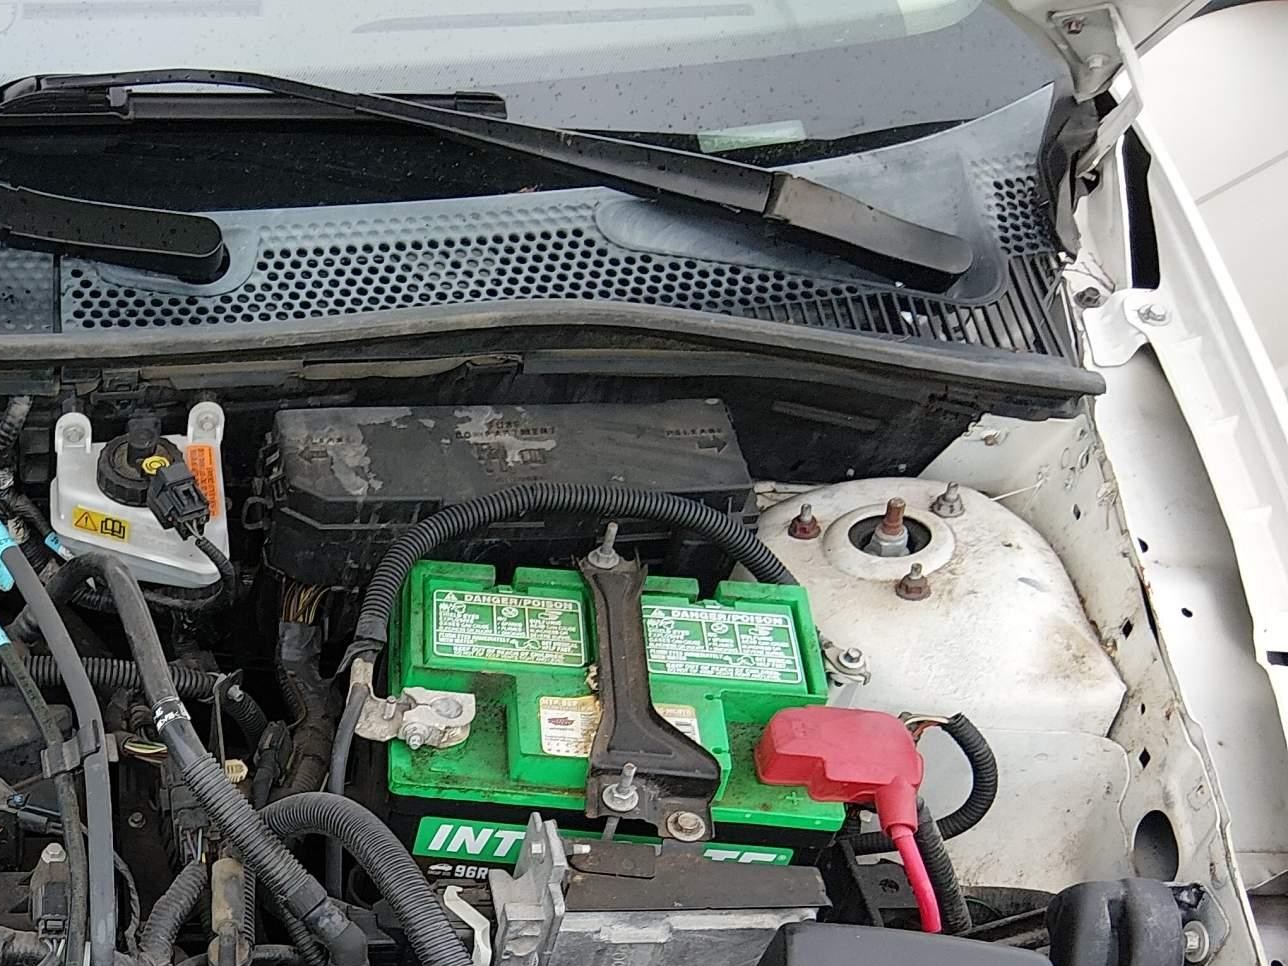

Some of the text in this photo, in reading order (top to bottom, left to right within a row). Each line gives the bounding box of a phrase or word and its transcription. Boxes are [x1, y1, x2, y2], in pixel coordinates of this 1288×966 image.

[464, 594, 573, 610] DANGER/POISON
[671, 610, 783, 624] DANGER/POISON
[454, 864, 489, 880] 96R
